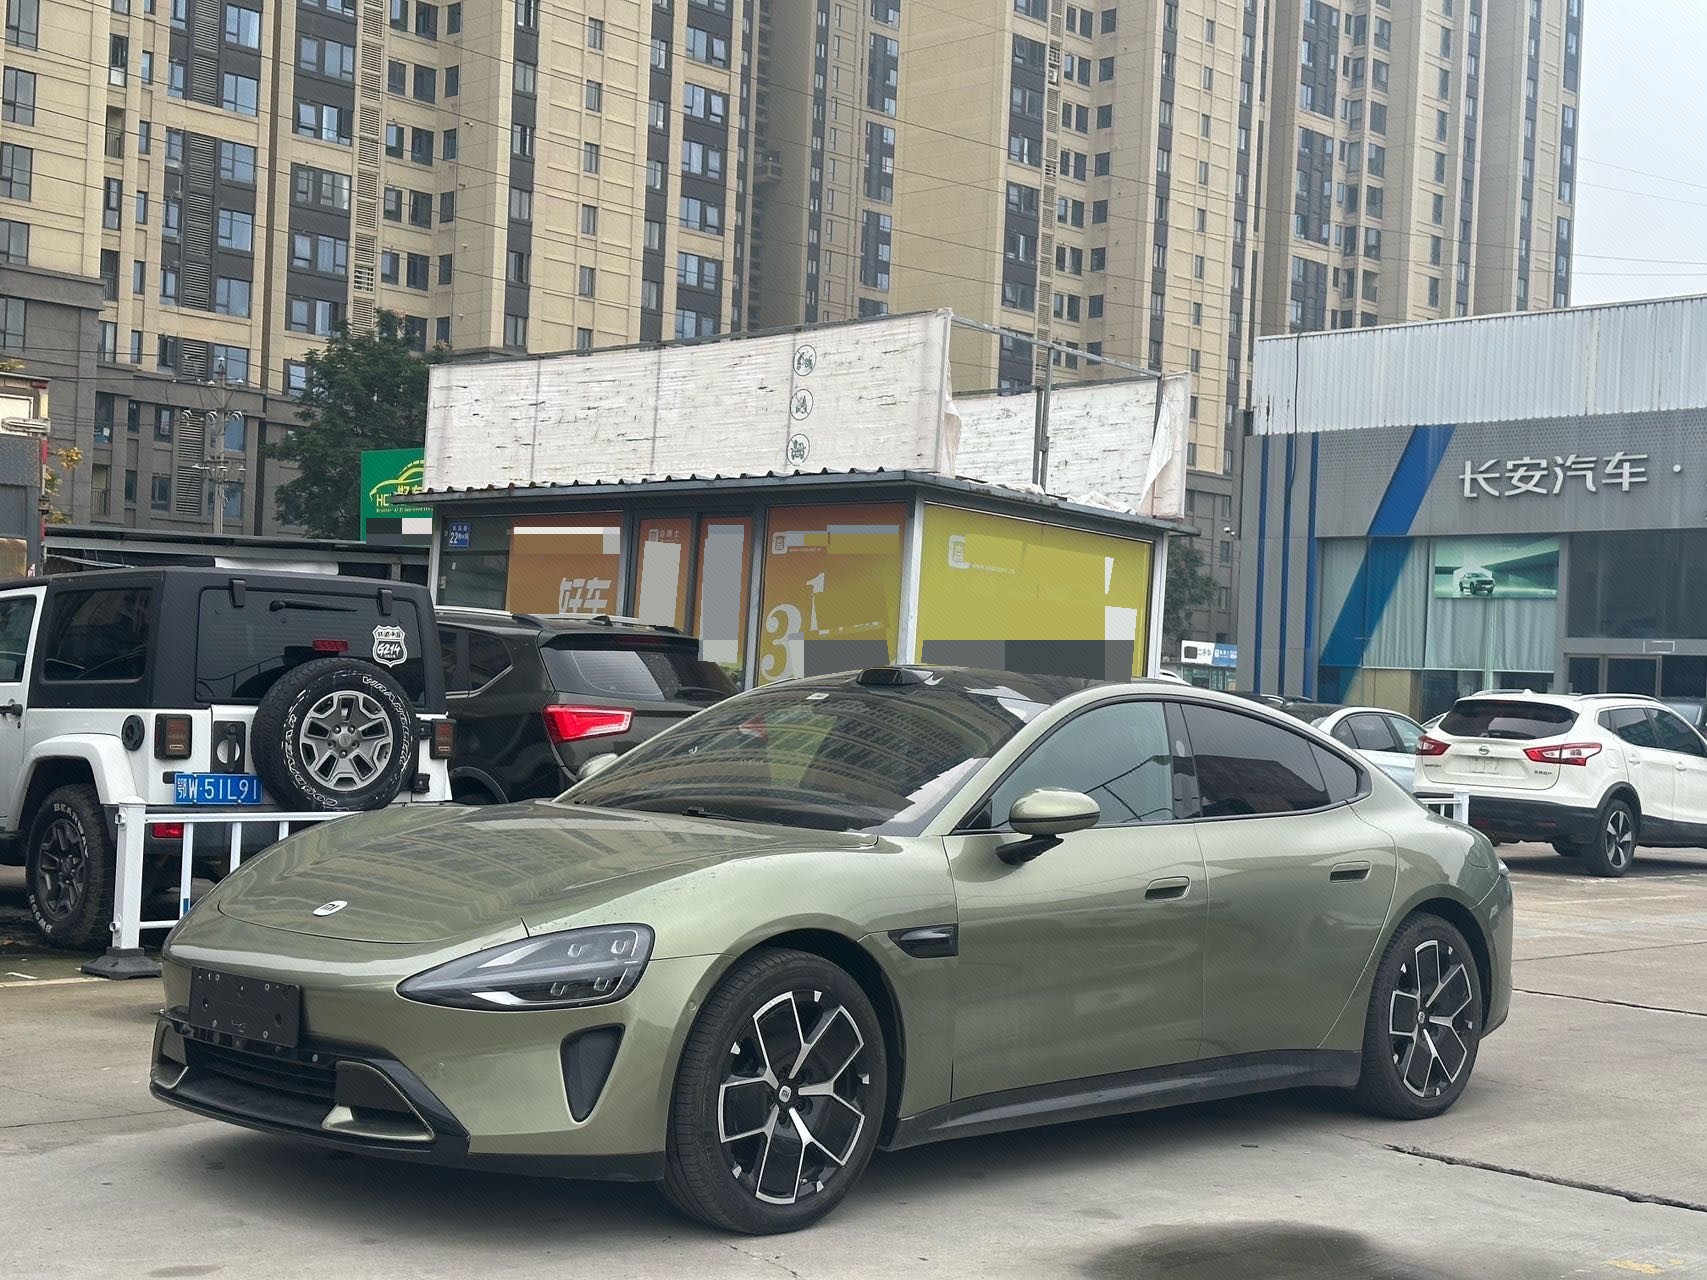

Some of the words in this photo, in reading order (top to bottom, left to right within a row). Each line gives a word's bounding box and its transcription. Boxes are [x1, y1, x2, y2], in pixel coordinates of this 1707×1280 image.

[1458, 451, 1648, 499] 长安汽车
[377, 643, 401, 657] G214
